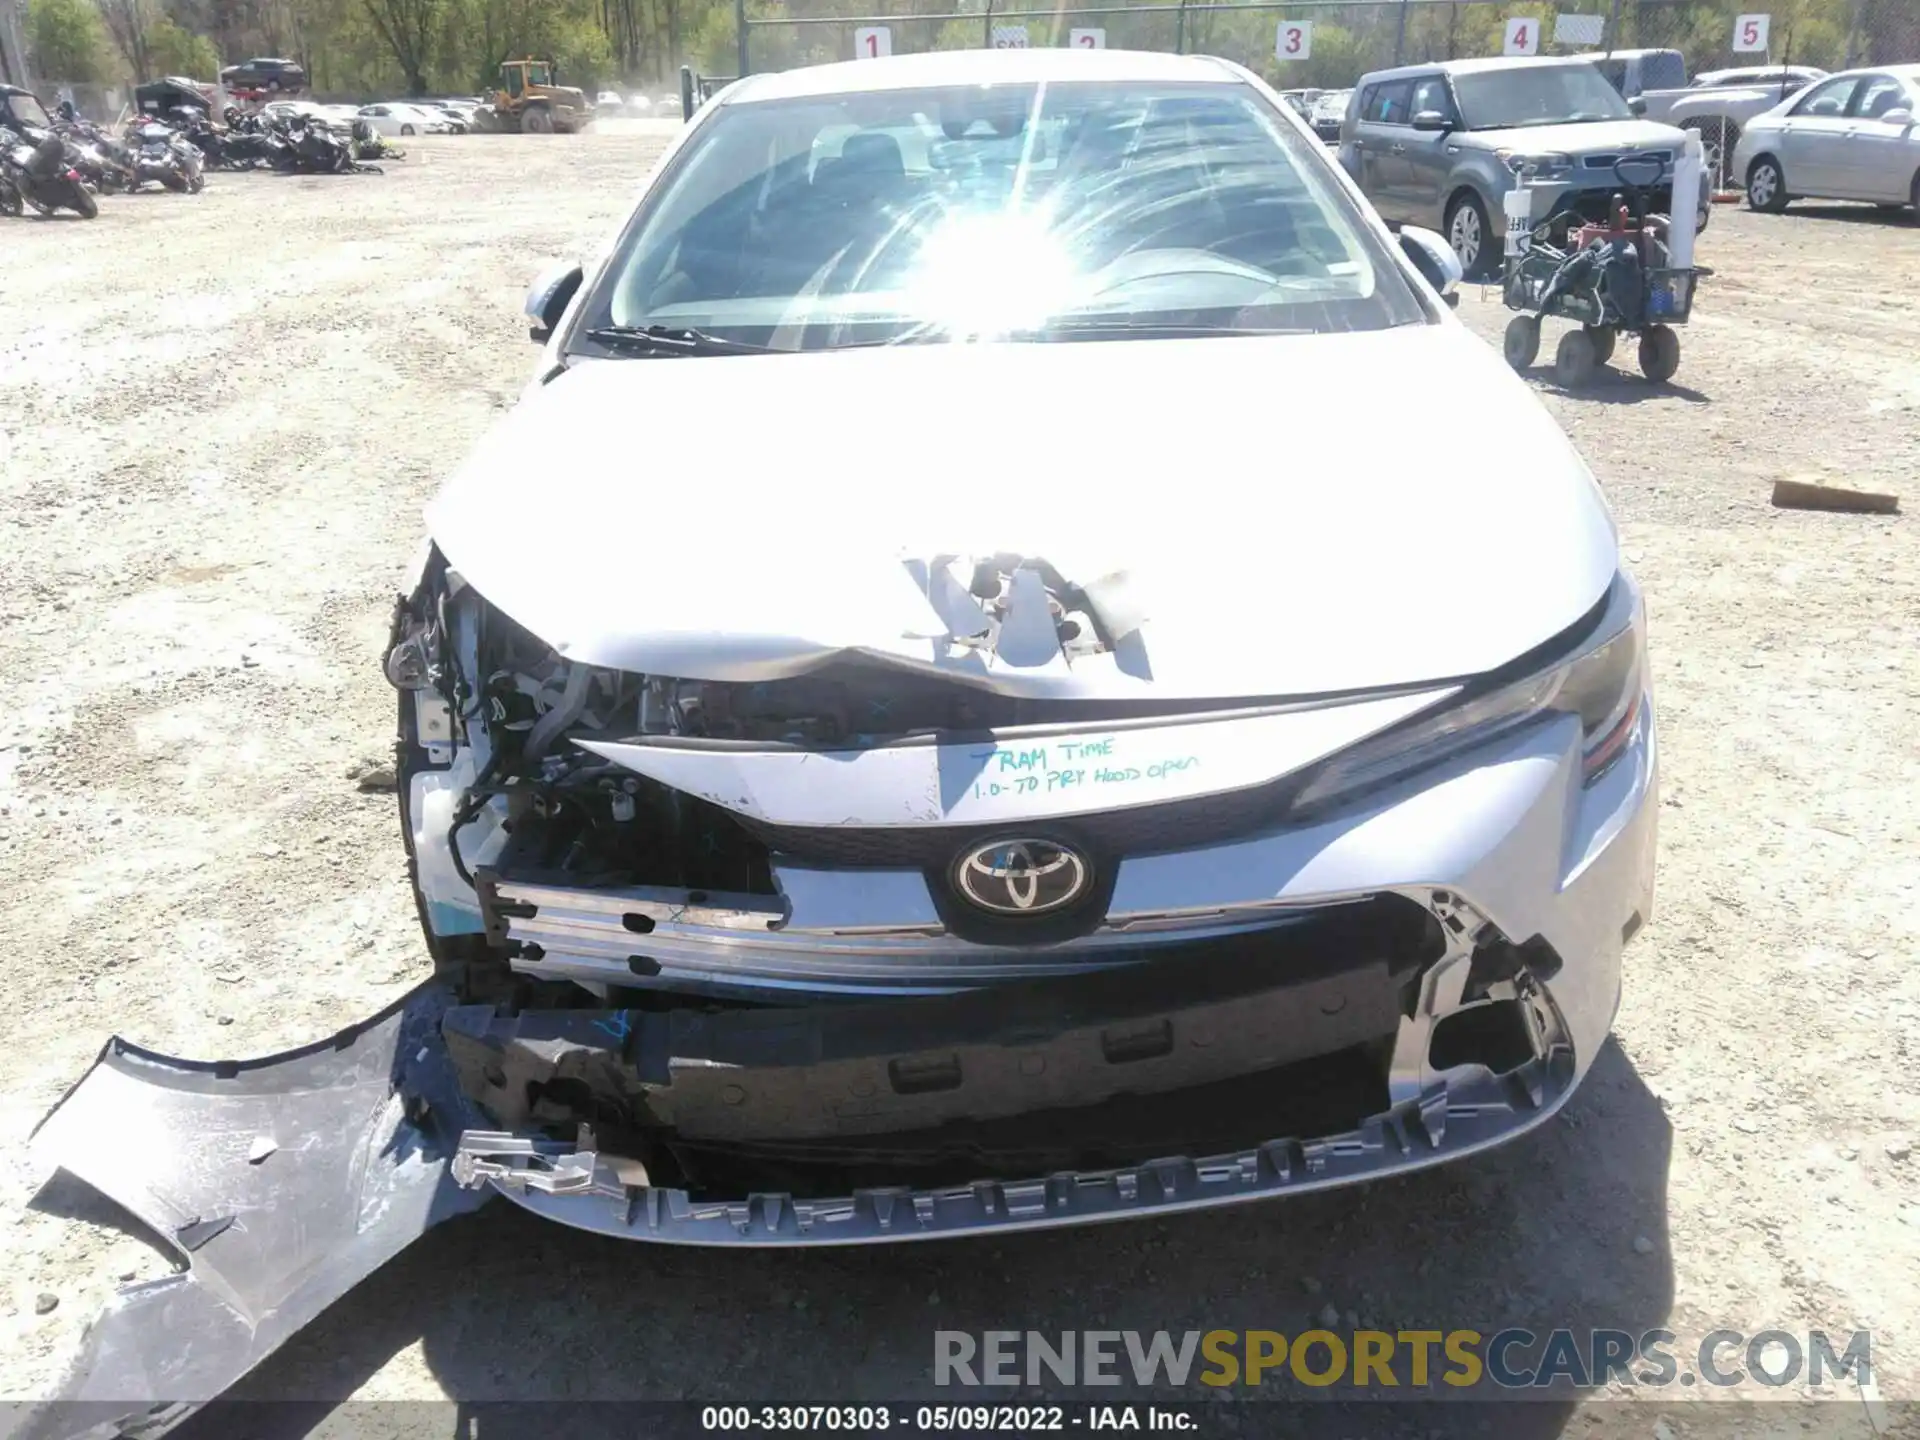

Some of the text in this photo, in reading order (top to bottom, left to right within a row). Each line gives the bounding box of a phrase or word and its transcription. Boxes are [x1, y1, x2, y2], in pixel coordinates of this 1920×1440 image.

[1285, 28, 1302, 54] 3
[1513, 25, 1529, 50] 4
[1744, 21, 1759, 46] 5
[866, 35, 878, 59] 1
